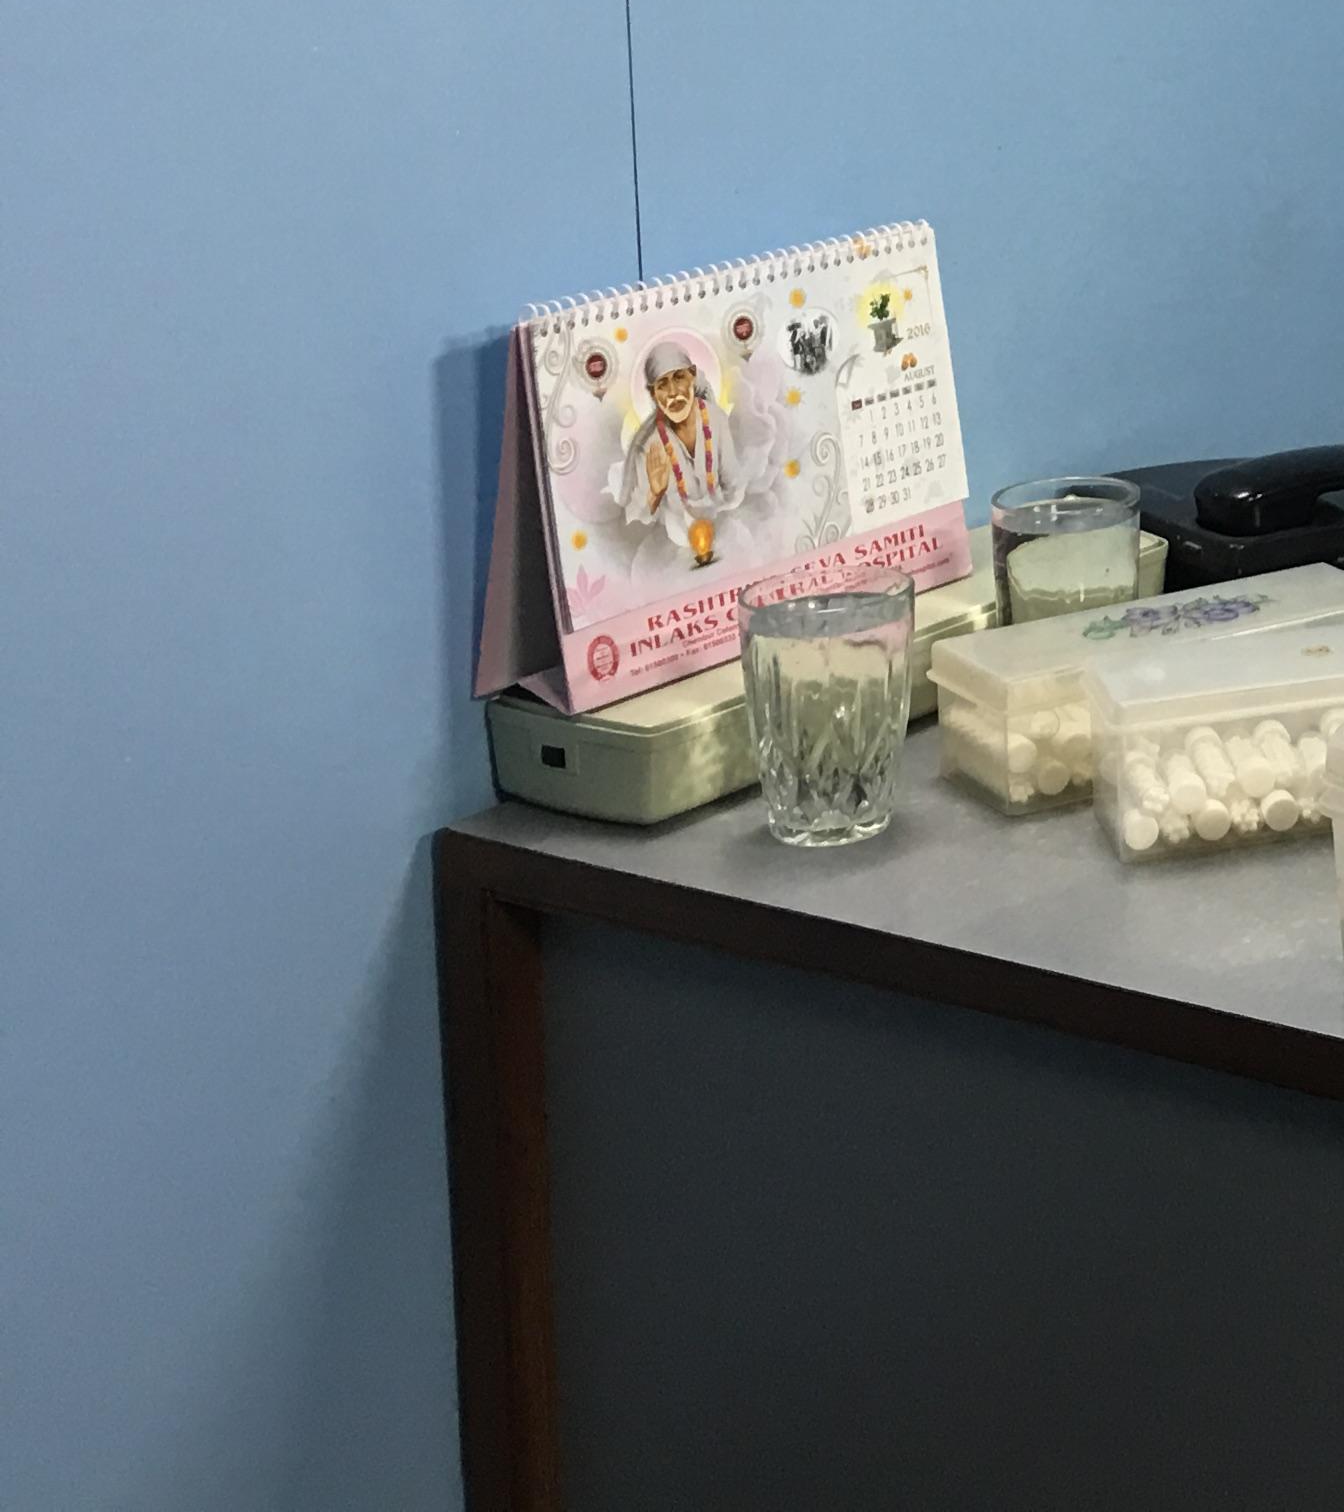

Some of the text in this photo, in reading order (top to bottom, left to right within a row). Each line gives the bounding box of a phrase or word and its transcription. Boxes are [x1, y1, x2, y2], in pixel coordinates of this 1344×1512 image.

[904, 365, 935, 382] AUGUST
[895, 422, 904, 437] 10
[908, 419, 915, 432] 11
[920, 415, 929, 429] 12
[932, 412, 941, 426] 13
[861, 432, 944, 470] 14 15 16 17 18 19 20
[863, 453, 946, 492] 21 22 23 24 25 26 27
[865, 487, 911, 514] 28 29 30 31
[854, 524, 925, 561] SAMITI
[630, 614, 719, 657] INLAKS
